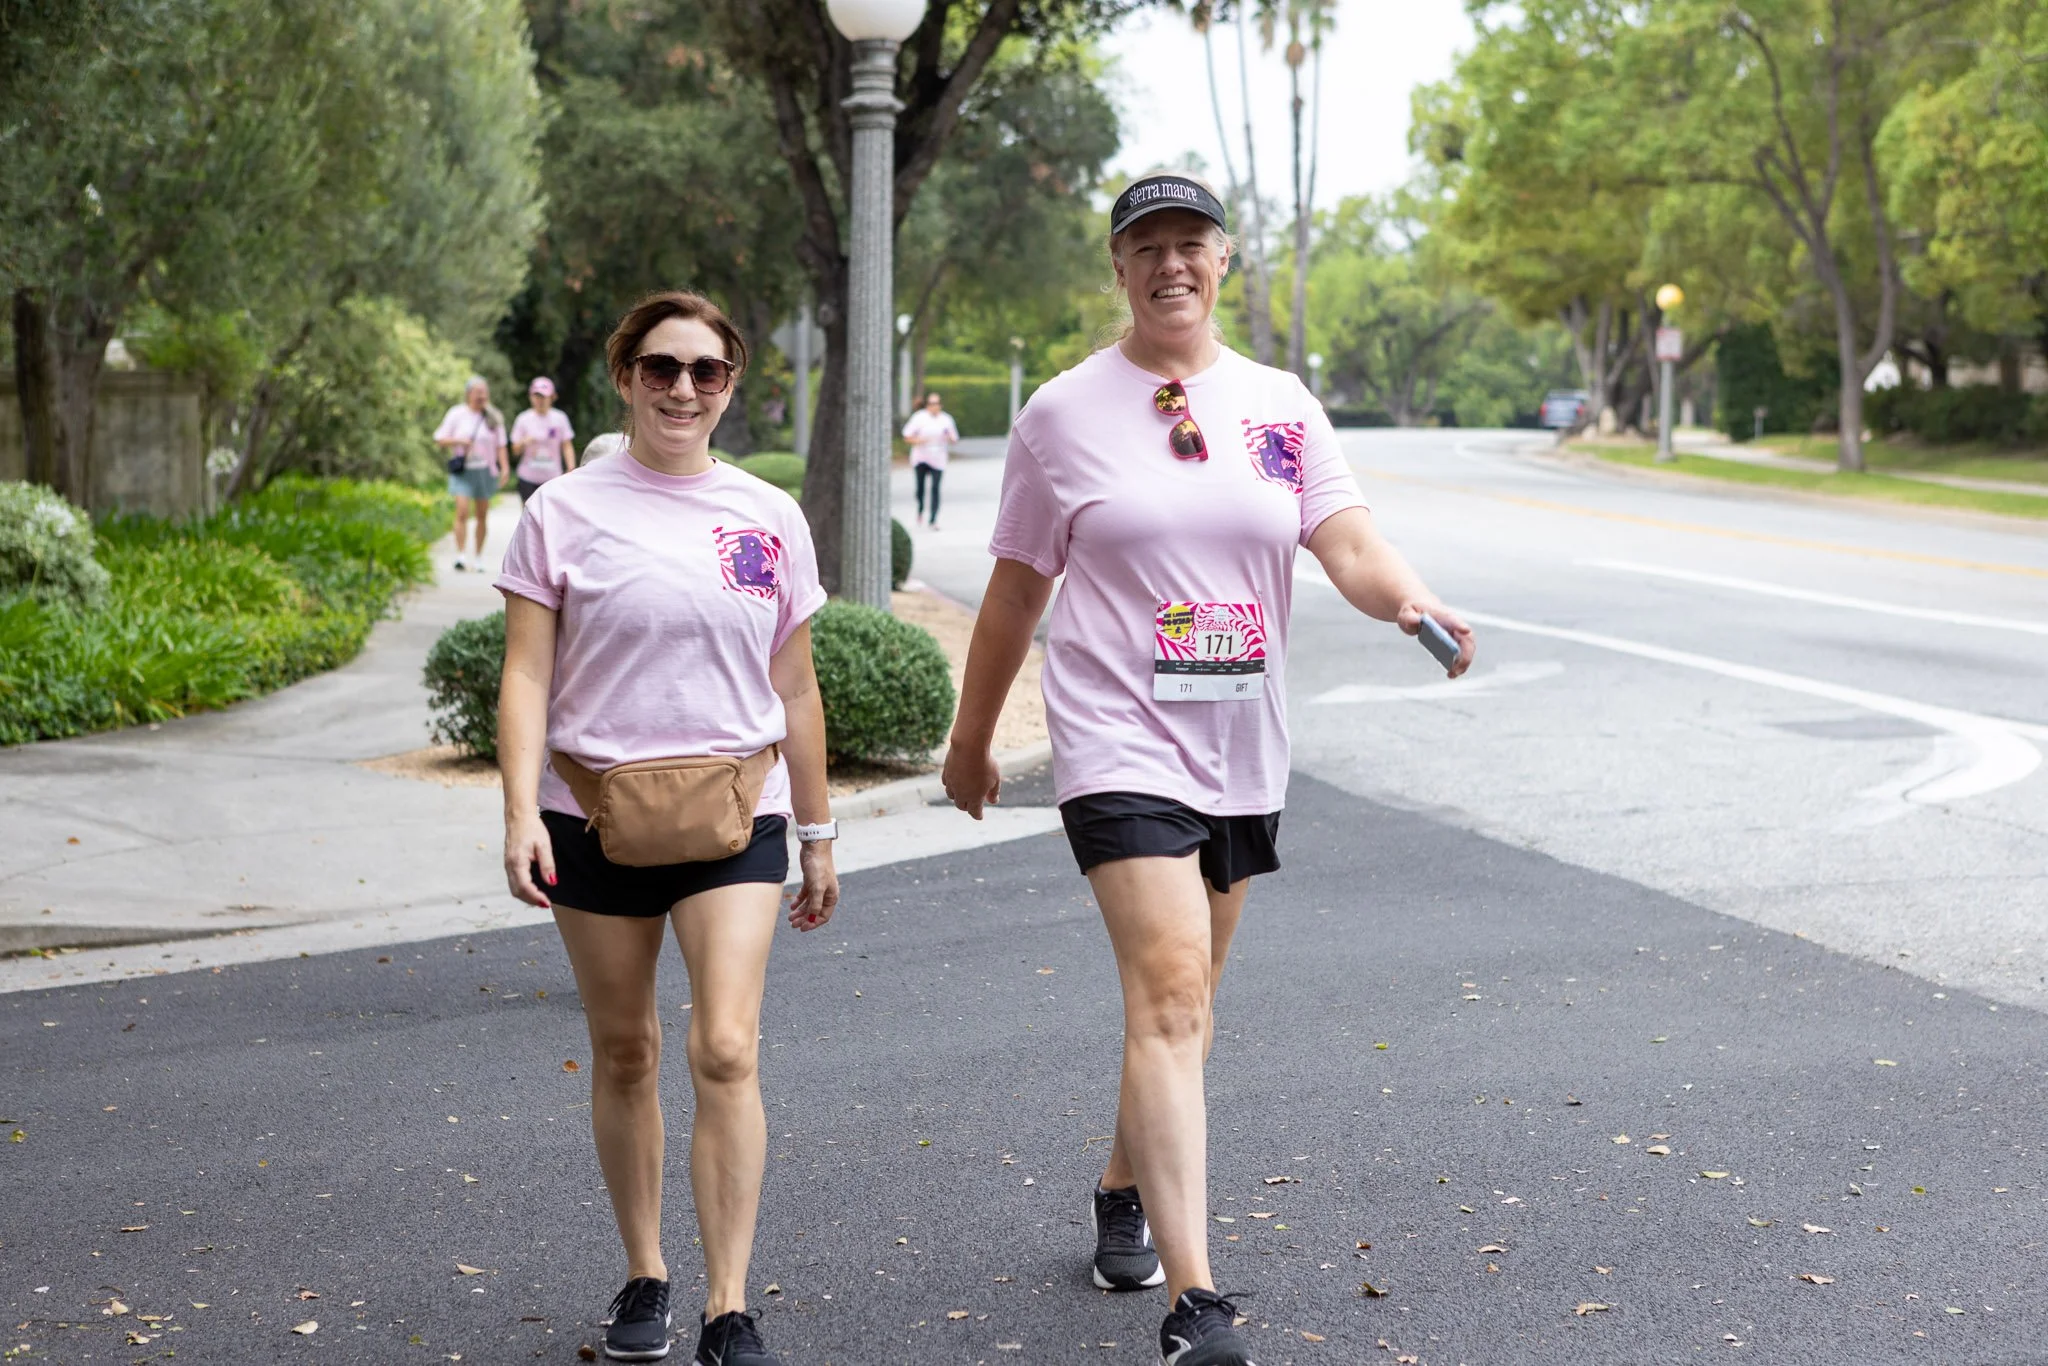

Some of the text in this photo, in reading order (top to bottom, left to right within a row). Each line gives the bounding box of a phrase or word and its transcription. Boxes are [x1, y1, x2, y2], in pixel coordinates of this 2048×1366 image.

[1129, 183, 1160, 208] sierra
[1205, 634, 1233, 655] 171
[1180, 683, 1193, 693] 171
[1235, 682, 1249, 693] GIFT
